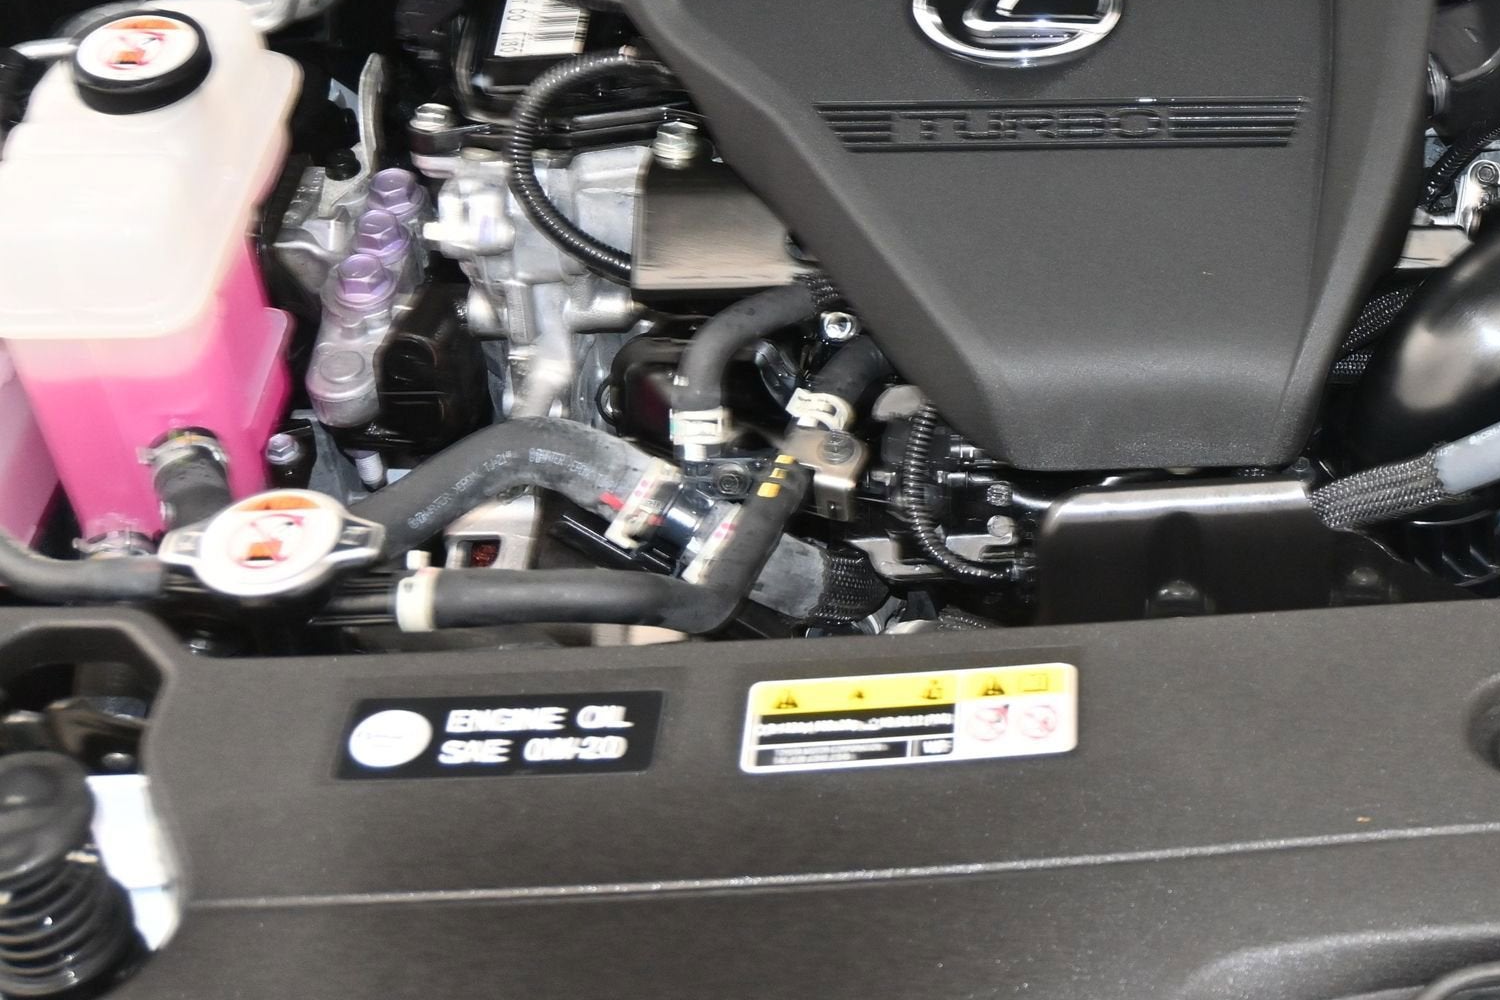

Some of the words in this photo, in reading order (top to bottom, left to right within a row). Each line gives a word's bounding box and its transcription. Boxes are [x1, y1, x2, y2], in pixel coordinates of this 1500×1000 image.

[900, 106, 1162, 140] TURBO
[445, 706, 569, 734] ENGINE
[576, 704, 635, 730] OIL
[437, 738, 514, 765] SAE
